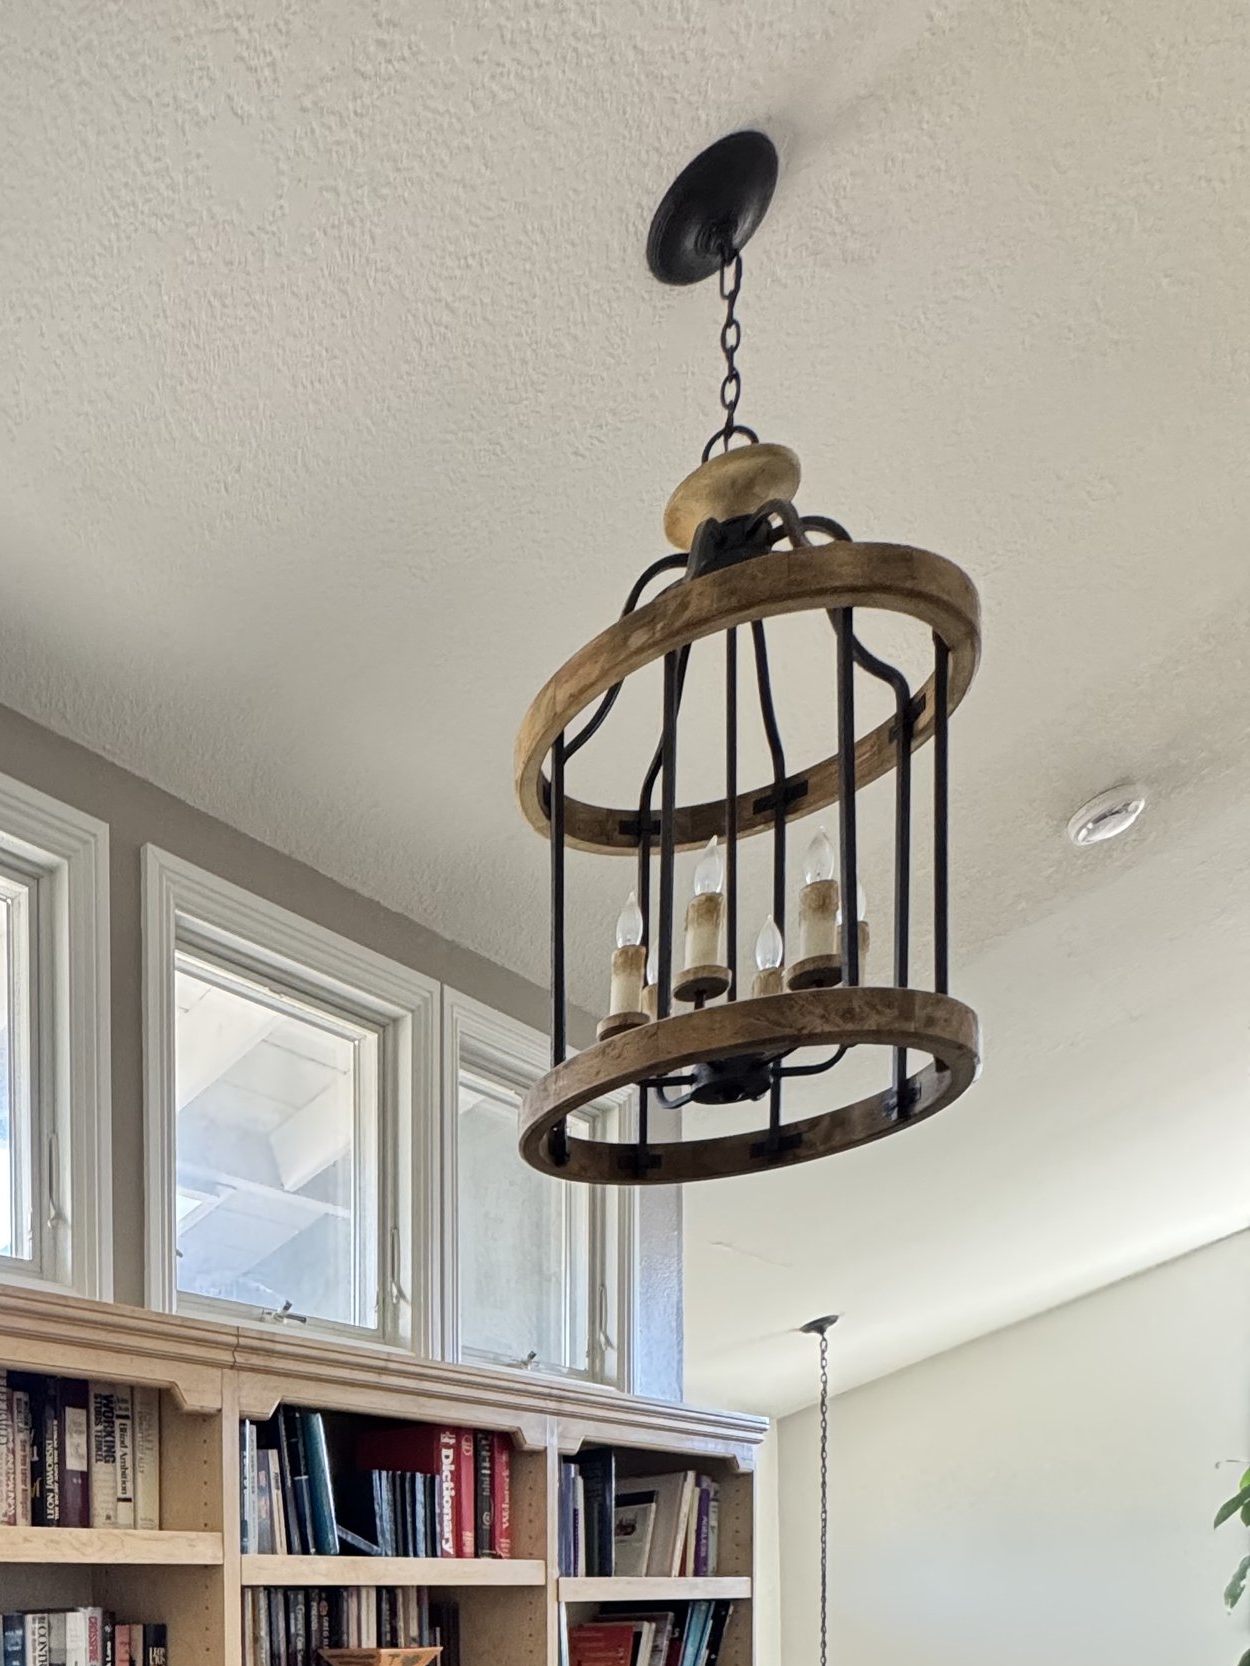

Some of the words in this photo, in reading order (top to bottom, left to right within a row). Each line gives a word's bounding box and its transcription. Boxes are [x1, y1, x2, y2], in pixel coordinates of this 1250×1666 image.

[102, 1394, 116, 1464] WORKING
[118, 1422, 128, 1449] Blind
[119, 1453, 128, 1495] Ambition
[441, 1448, 455, 1554] Dictionary
